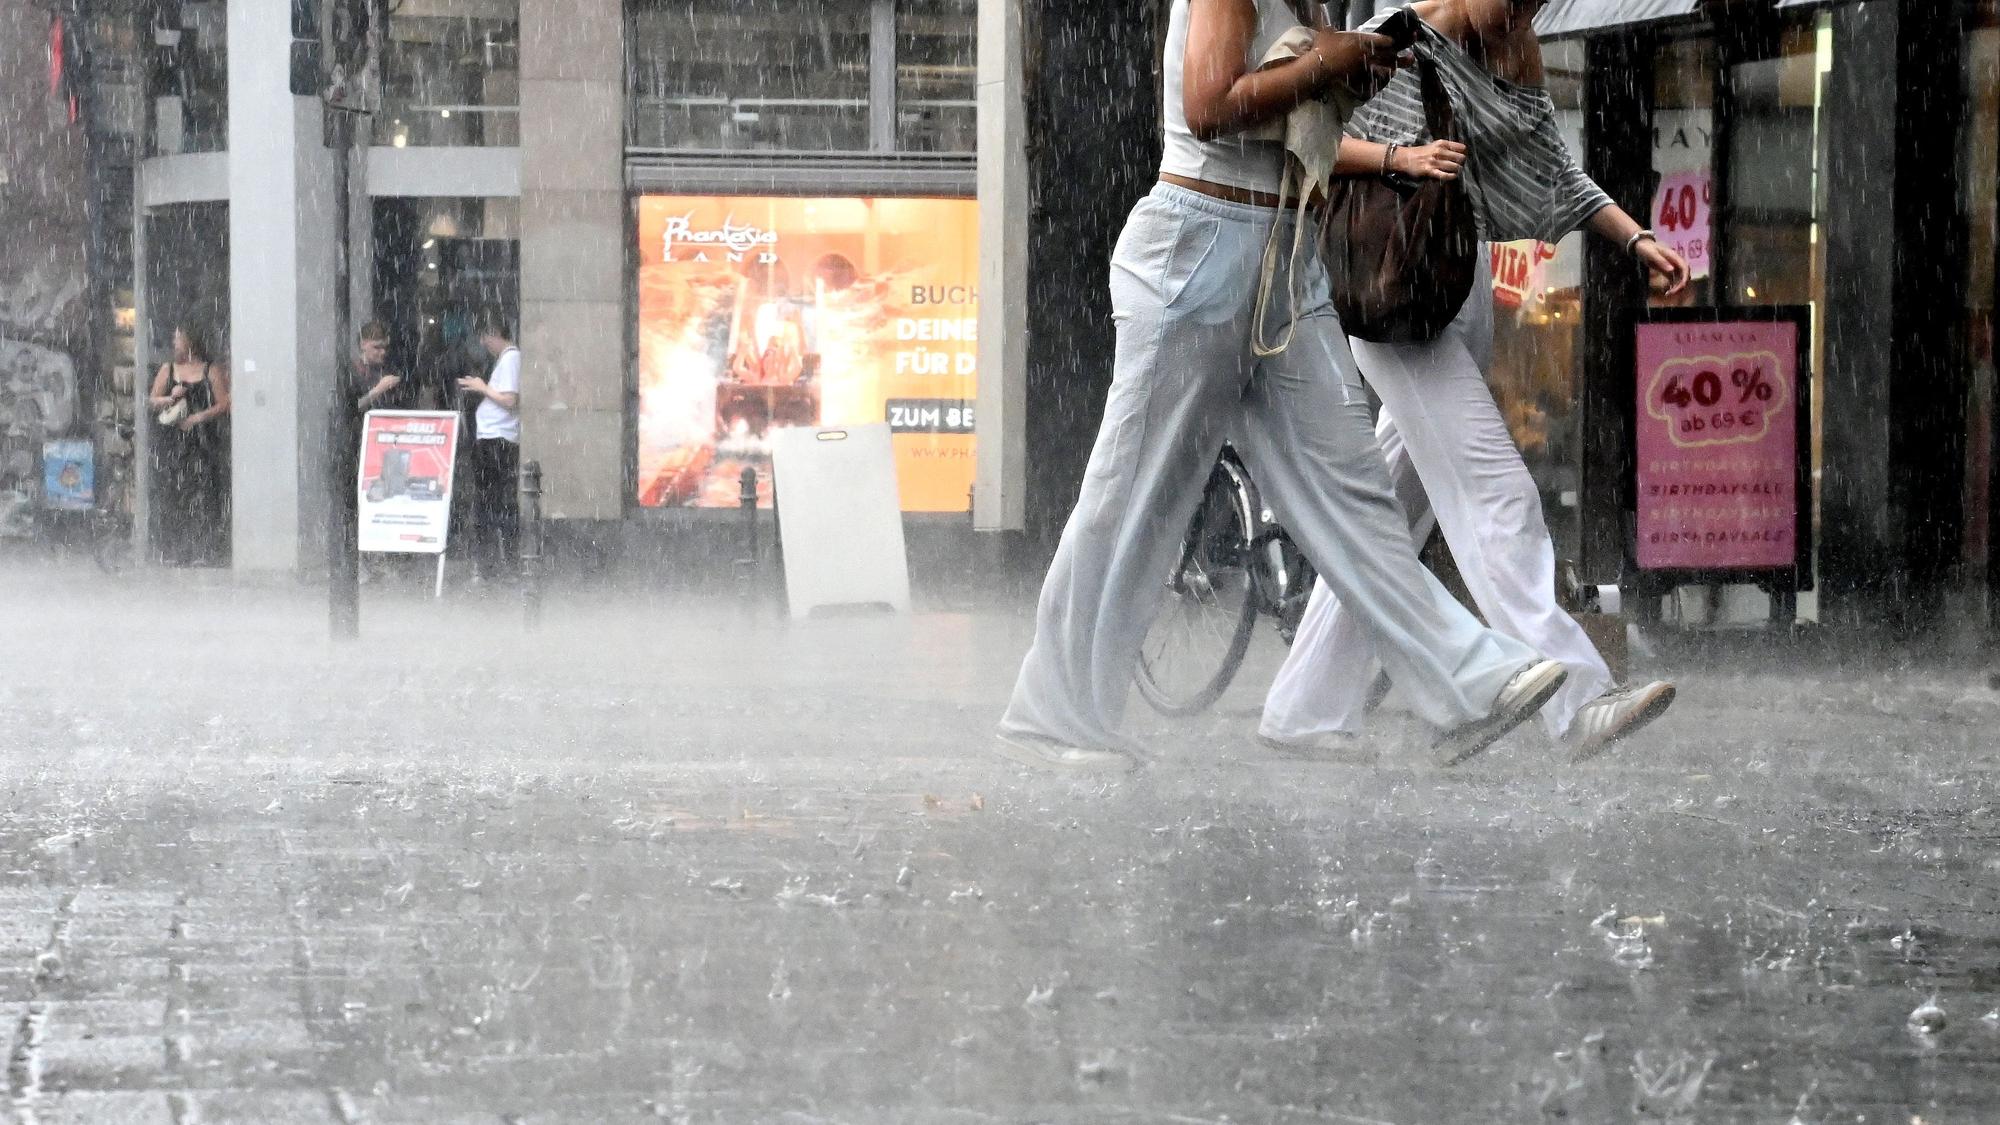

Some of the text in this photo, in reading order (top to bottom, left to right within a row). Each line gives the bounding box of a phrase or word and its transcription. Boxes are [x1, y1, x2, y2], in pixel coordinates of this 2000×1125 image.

[1660, 185, 1696, 232] 40
[663, 251, 779, 263] LAND
[898, 319, 977, 340] DEINE
[896, 346, 947, 373] FÜR
[1661, 366, 1772, 407] 40 %
[890, 407, 939, 427] ZUM
[1681, 416, 1705, 432] ab
[1711, 412, 1735, 429] 69
[1650, 483, 1785, 495] BIRTHDAYSALE
